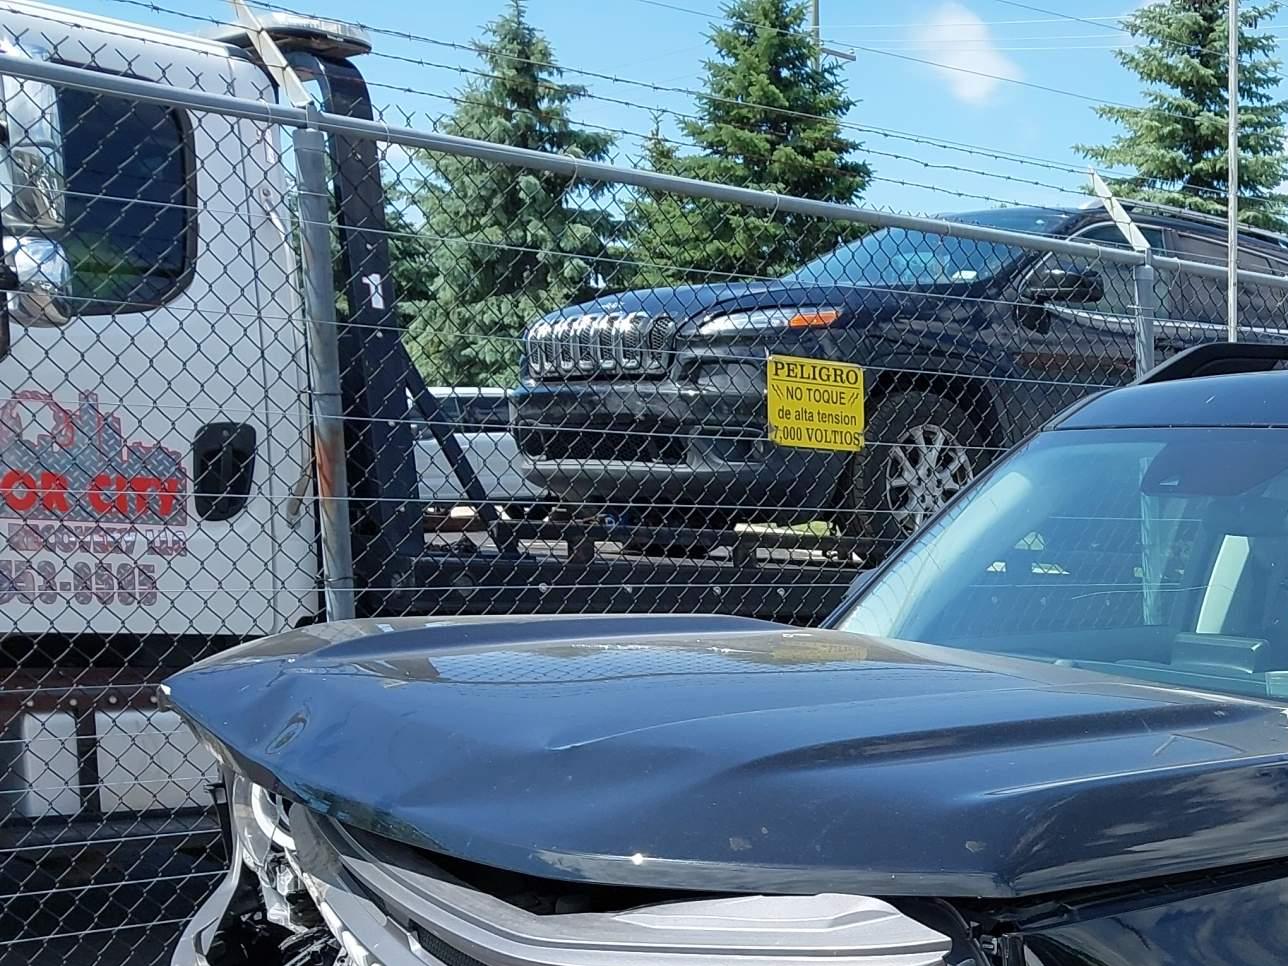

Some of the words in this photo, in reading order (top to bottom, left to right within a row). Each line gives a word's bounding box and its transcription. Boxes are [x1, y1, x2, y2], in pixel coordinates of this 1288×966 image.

[773, 361, 858, 385] PELIGRO
[786, 386, 803, 402] NO
[806, 388, 846, 405] TOQUE
[778, 405, 791, 420] de
[795, 407, 814, 422] alta
[817, 411, 857, 426] tension
[773, 425, 802, 441] 7,000
[806, 428, 861, 446] VOLTIOS
[88, 474, 179, 517] CITY
